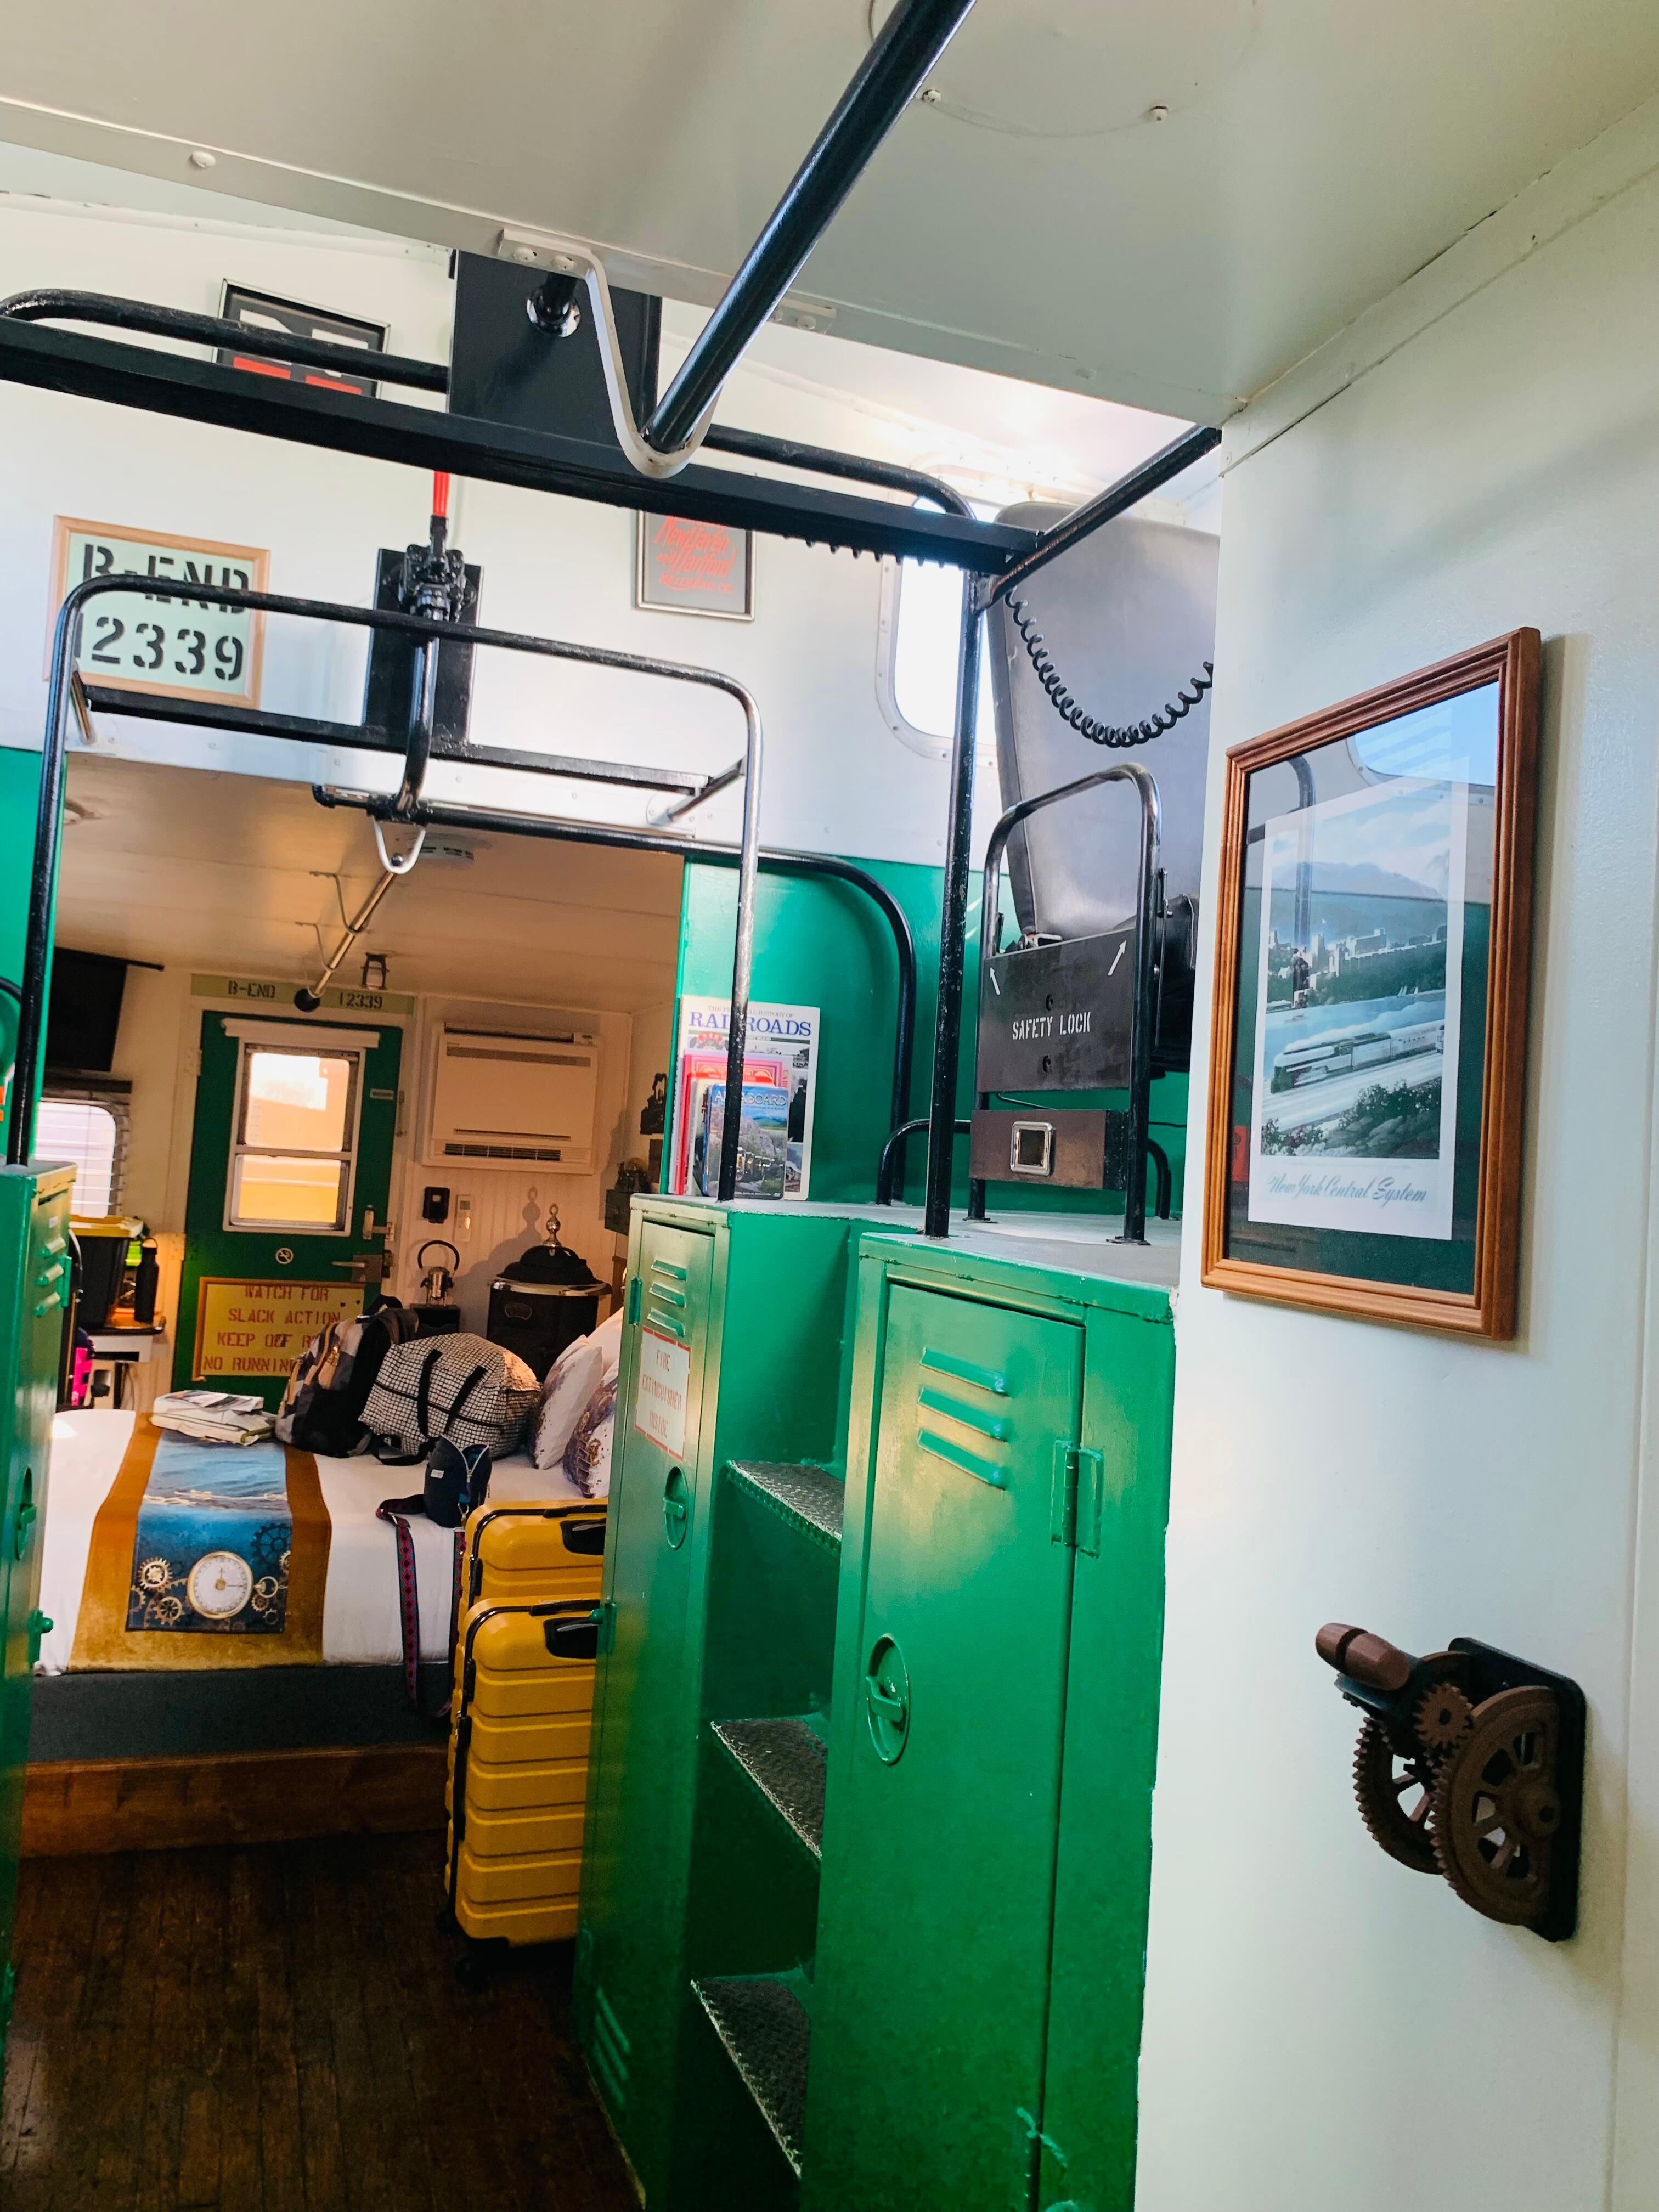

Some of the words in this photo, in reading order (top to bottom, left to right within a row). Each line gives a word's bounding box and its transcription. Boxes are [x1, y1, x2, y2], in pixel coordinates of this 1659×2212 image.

[228, 980, 275, 999] B-END
[339, 992, 383, 1010] 12339
[690, 1012, 811, 1036] RAIROADS
[1012, 1015, 1053, 1040] SAFETY
[1059, 1011, 1091, 1035] LOCK
[1267, 1171, 1294, 1194] New
[1293, 1173, 1327, 1200] York
[1323, 1175, 1376, 1199] Central
[1372, 1177, 1427, 1208] System
[245, 1285, 292, 1300] WATCH
[301, 1286, 329, 1301] FOR
[228, 1308, 275, 1323] SLACK
[284, 1311, 341, 1324] ACTION
[217, 1332, 255, 1347] KEEP
[203, 1356, 223, 1371] NO
[656, 1350, 670, 1372] FIRE
[642, 1374, 681, 1412] EXTINGUISHER
[650, 1410, 668, 1438] INSIDE
